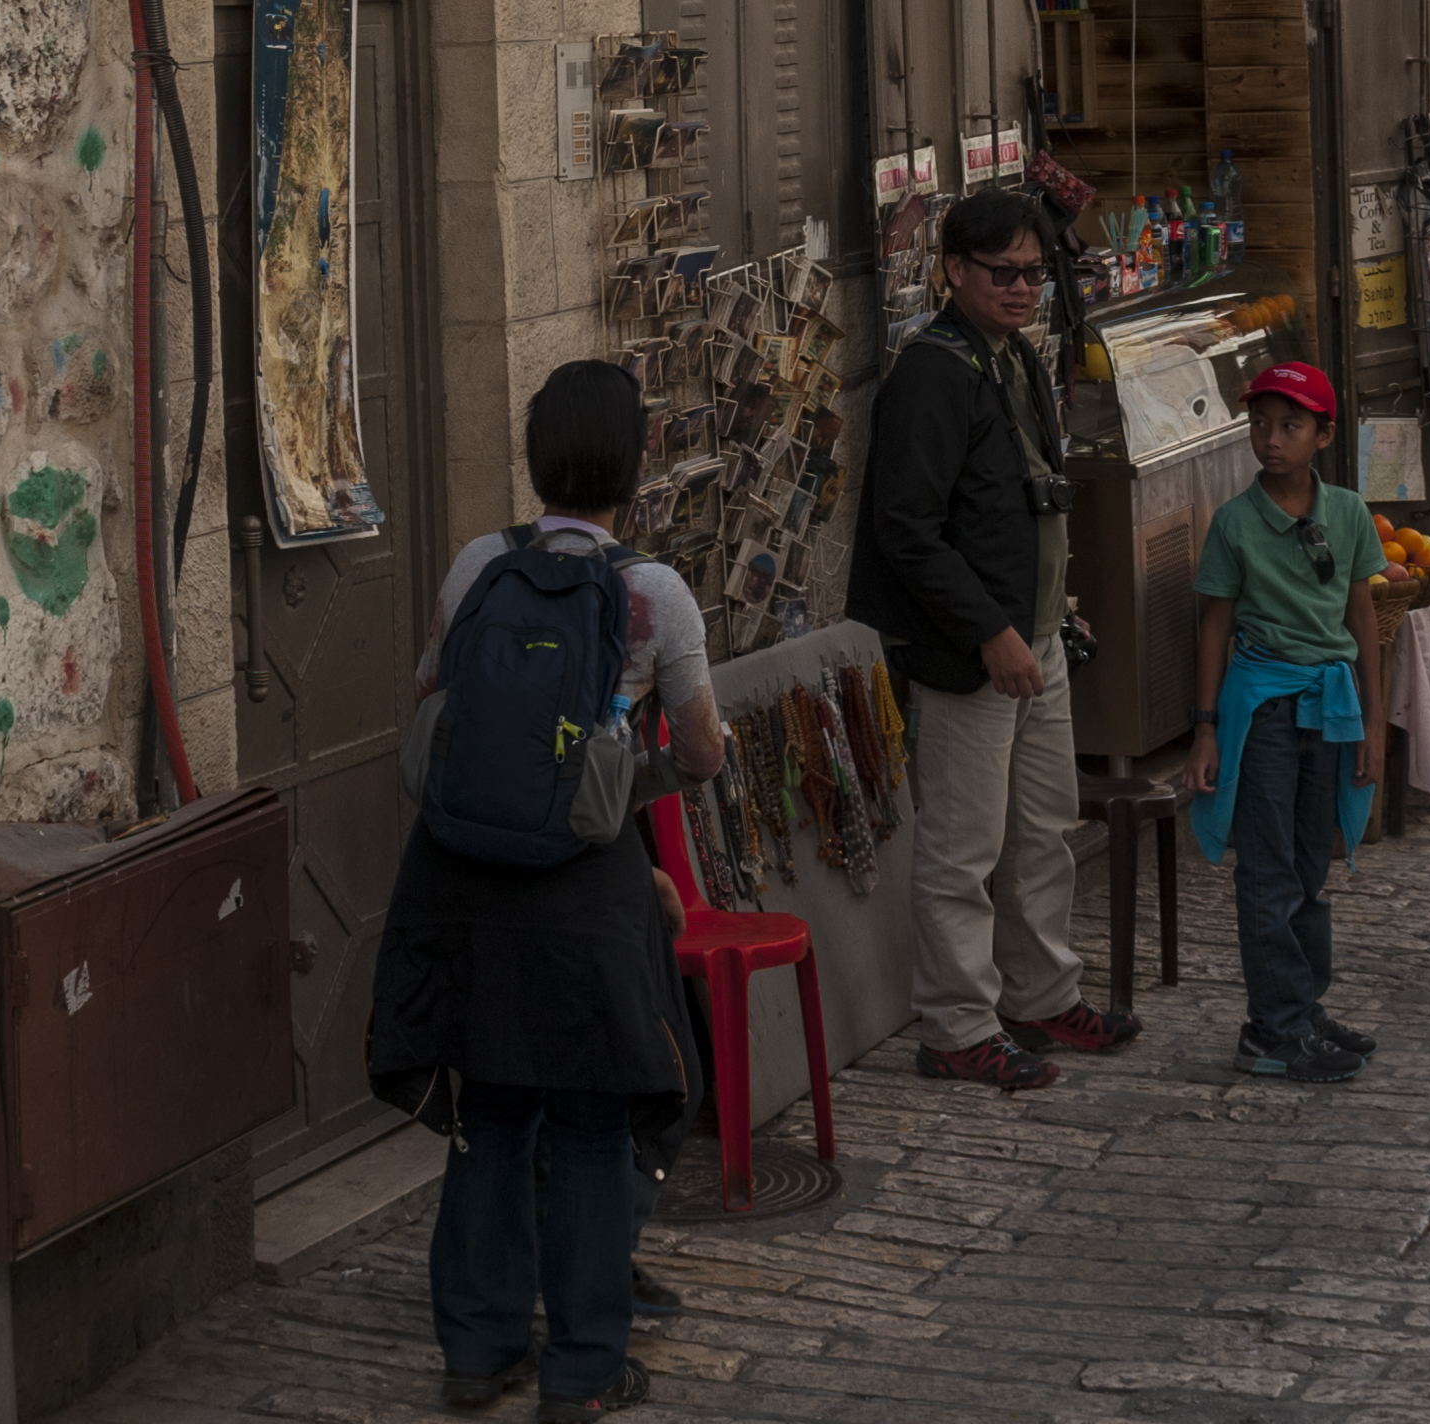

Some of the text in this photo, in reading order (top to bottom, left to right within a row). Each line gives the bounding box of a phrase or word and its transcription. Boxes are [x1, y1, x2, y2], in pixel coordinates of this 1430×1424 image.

[969, 144, 1017, 168] PALOT
[1371, 220, 1382, 234] &
[1367, 237, 1386, 252] Tea
